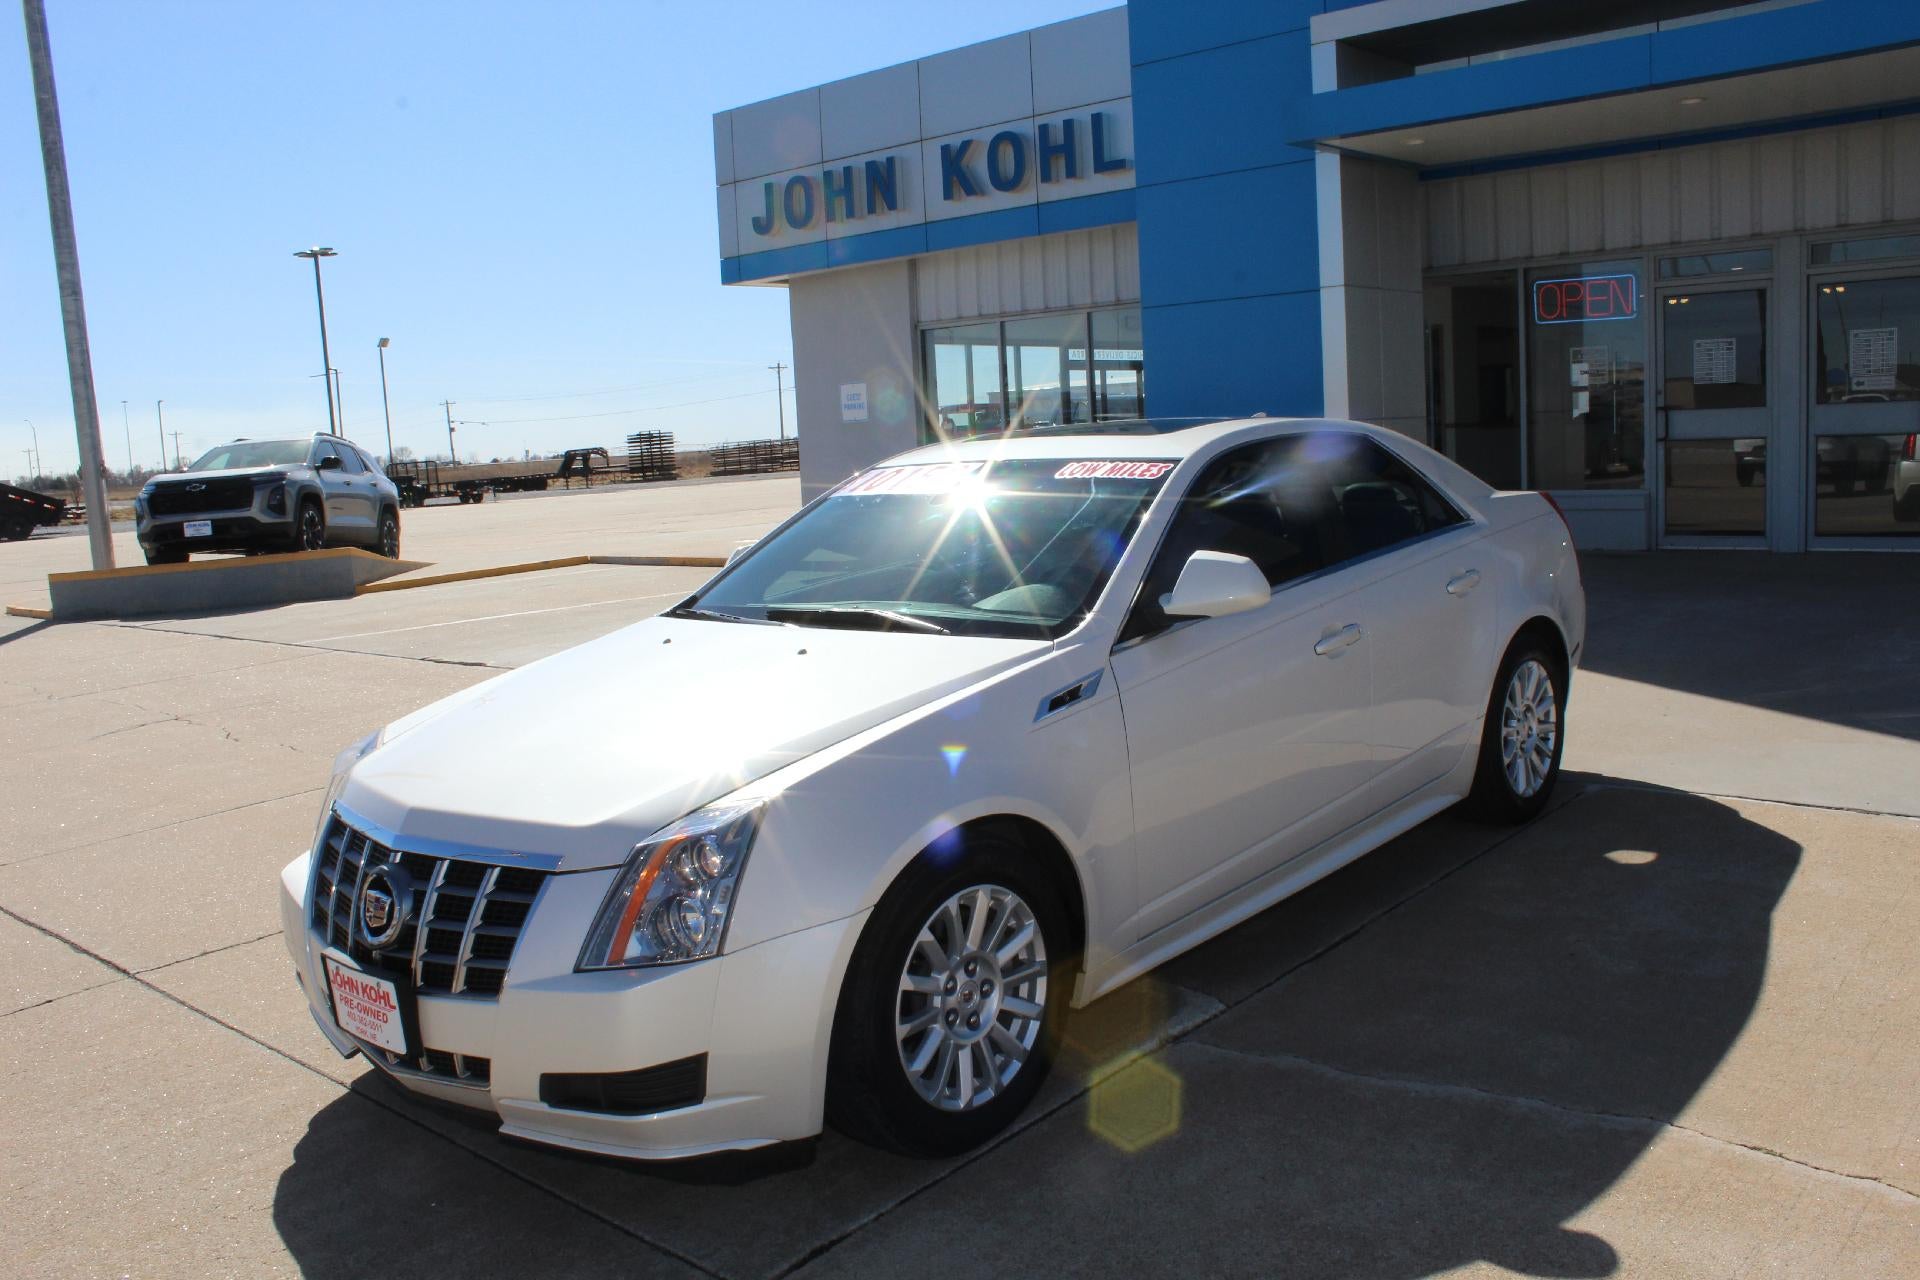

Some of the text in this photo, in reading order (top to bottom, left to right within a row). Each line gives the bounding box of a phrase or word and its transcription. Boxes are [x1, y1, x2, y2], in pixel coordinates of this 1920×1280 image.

[752, 112, 1128, 236] JOHN KOHL
[1538, 278, 1633, 319] OPEN
[1057, 462, 1171, 478] LOW MILES
[331, 970, 397, 1010] JOHN KOHL
[339, 993, 389, 1024] PRE-OWNED
